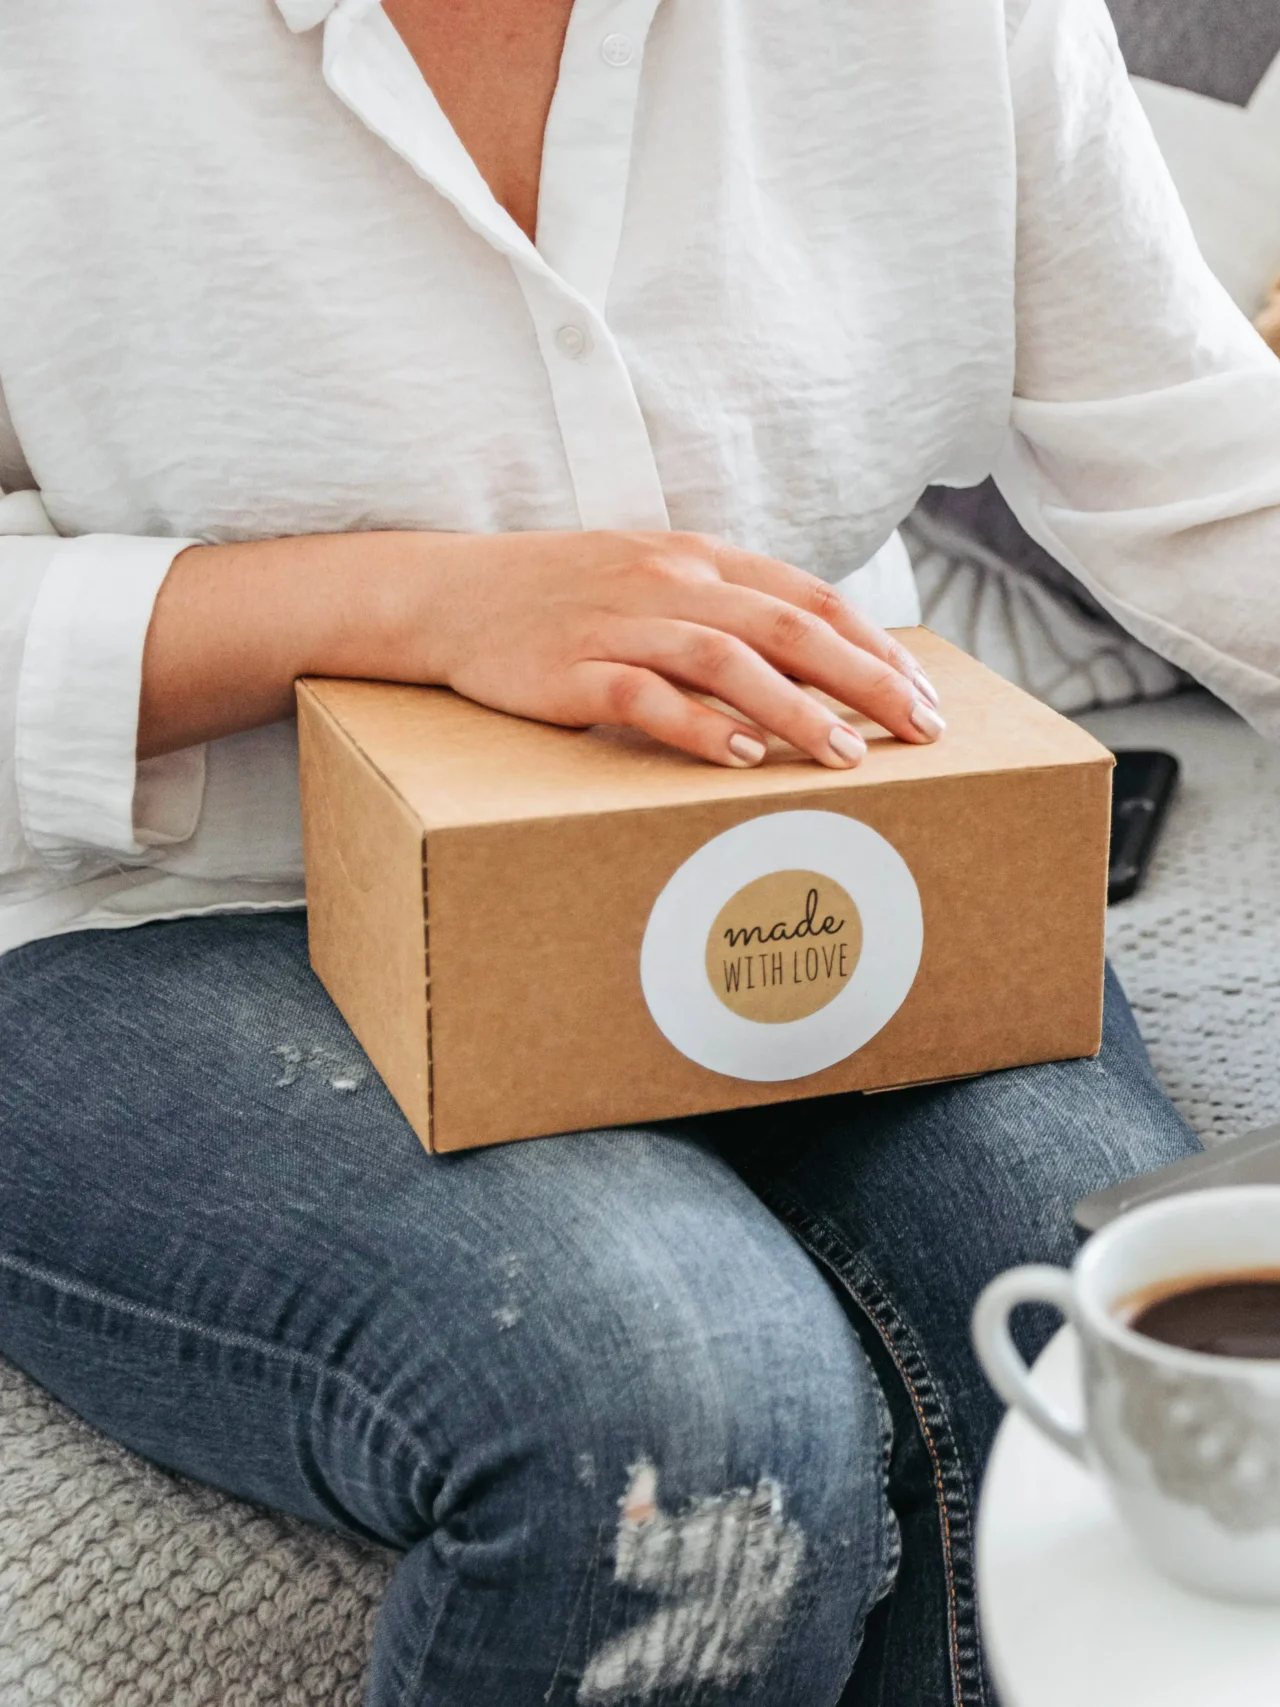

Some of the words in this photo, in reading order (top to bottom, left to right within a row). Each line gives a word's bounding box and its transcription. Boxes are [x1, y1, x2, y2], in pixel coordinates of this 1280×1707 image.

[723, 888, 845, 948] made
[723, 950, 784, 993] WITH
[793, 943, 849, 984] LOVE
